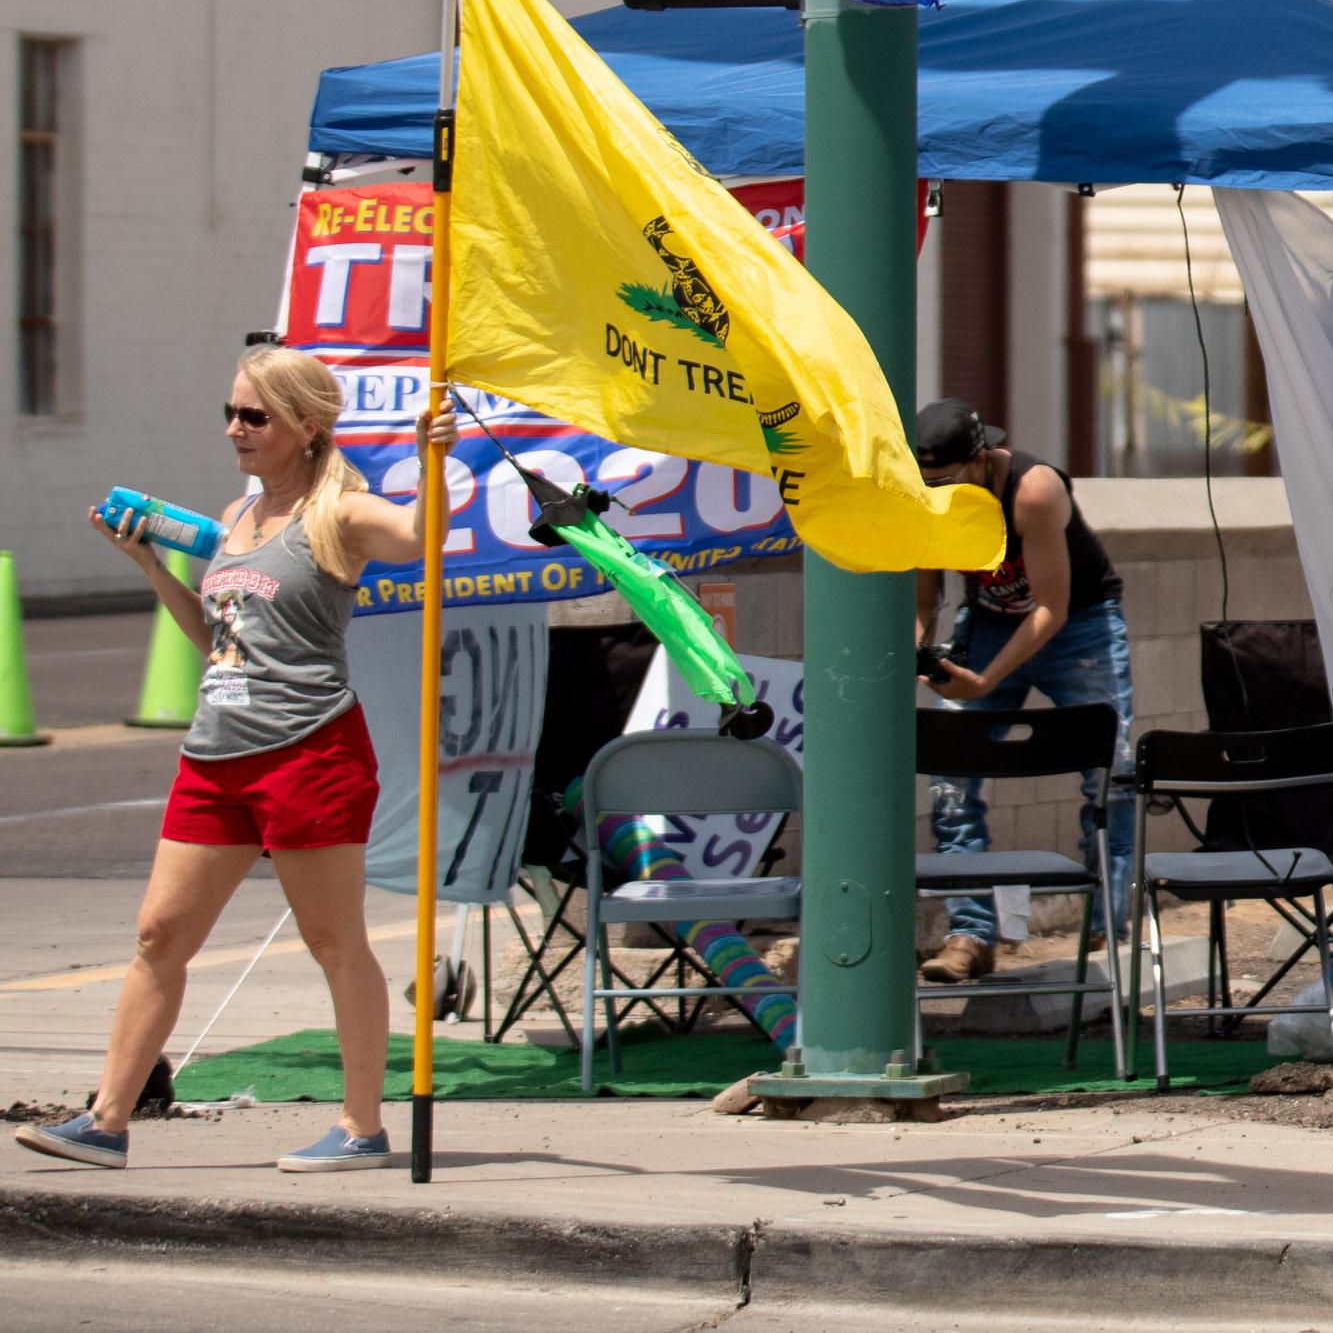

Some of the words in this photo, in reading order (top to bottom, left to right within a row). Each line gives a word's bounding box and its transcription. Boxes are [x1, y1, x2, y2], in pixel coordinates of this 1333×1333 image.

[606, 322, 667, 385] DONT
[678, 359, 754, 405] TRE
[378, 570, 532, 604] PREIDENT
